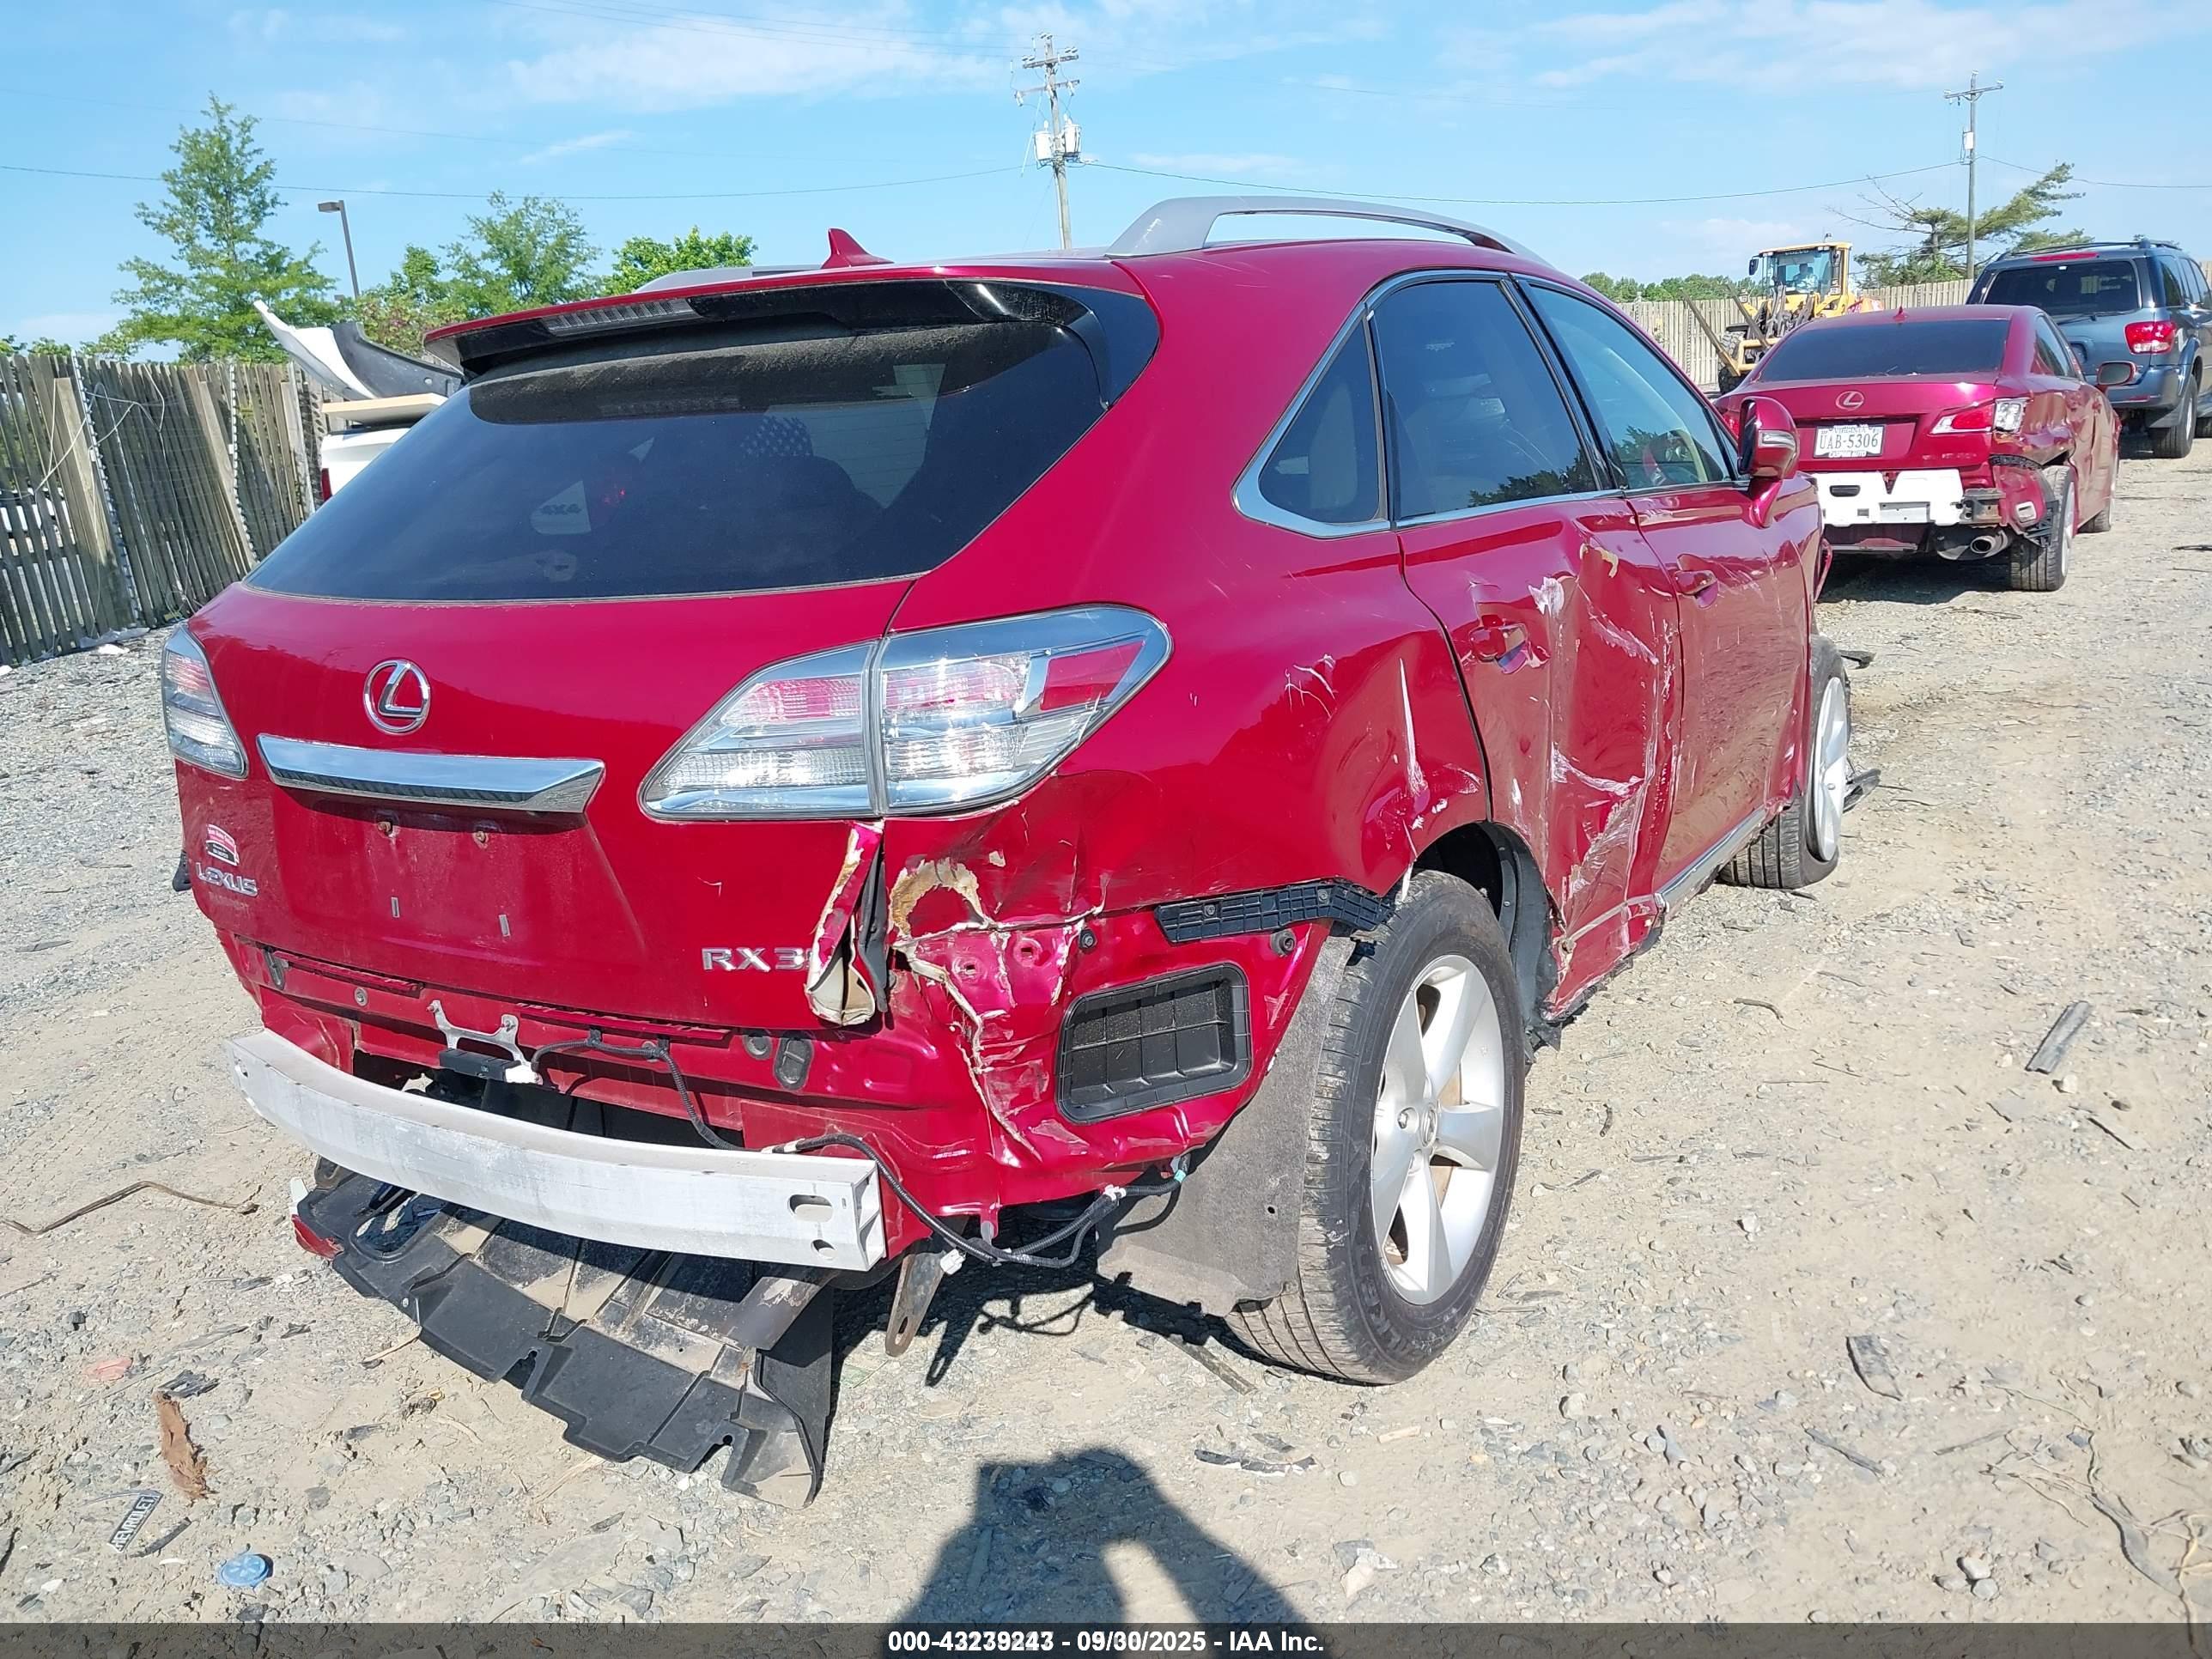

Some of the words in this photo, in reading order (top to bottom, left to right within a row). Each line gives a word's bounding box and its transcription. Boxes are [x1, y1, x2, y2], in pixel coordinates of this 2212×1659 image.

[1820, 433, 1879, 449] UAB-5306
[196, 862, 258, 897] LEXUS
[701, 947, 770, 972] RX
[774, 947, 813, 971] 3
[112, 1496, 155, 1550] HEVROLET
